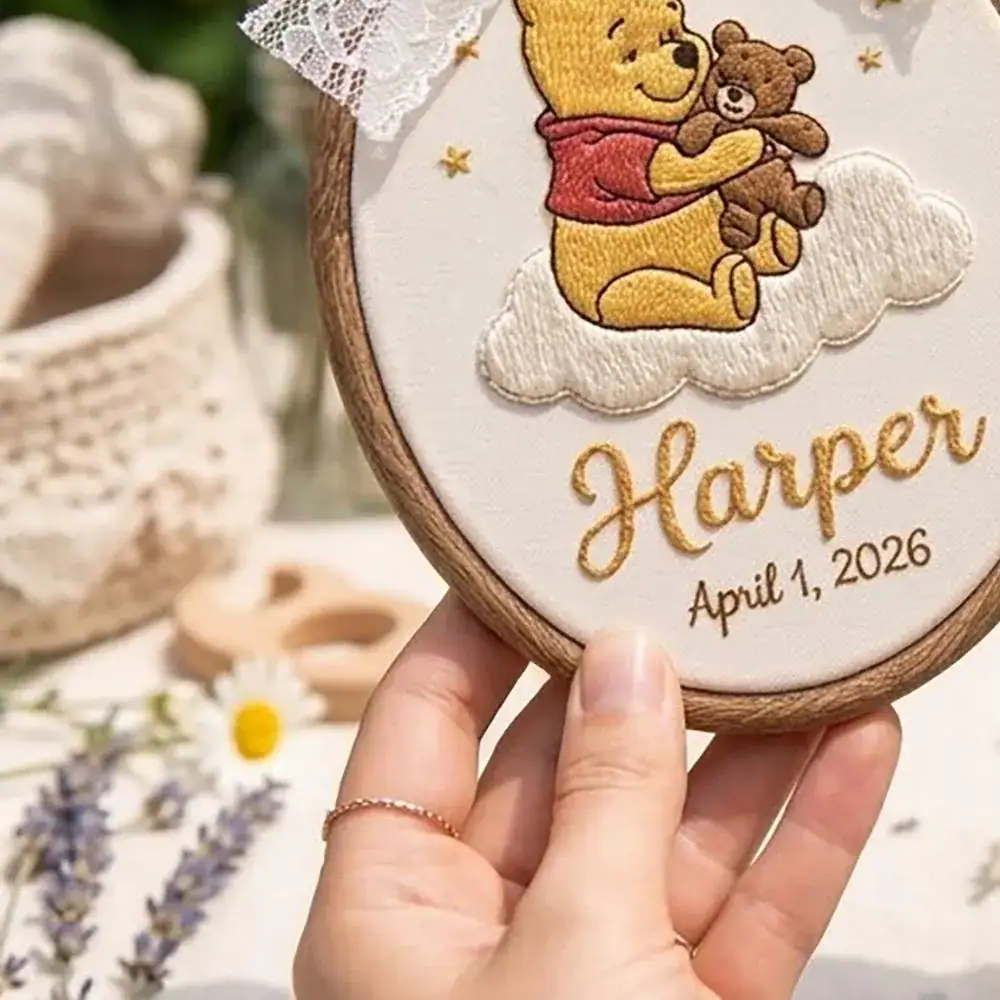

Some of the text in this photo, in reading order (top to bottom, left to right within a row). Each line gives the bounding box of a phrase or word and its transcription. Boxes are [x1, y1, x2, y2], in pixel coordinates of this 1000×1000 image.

[571, 394, 987, 581] Harper
[688, 527, 931, 638] April 1, 2026
